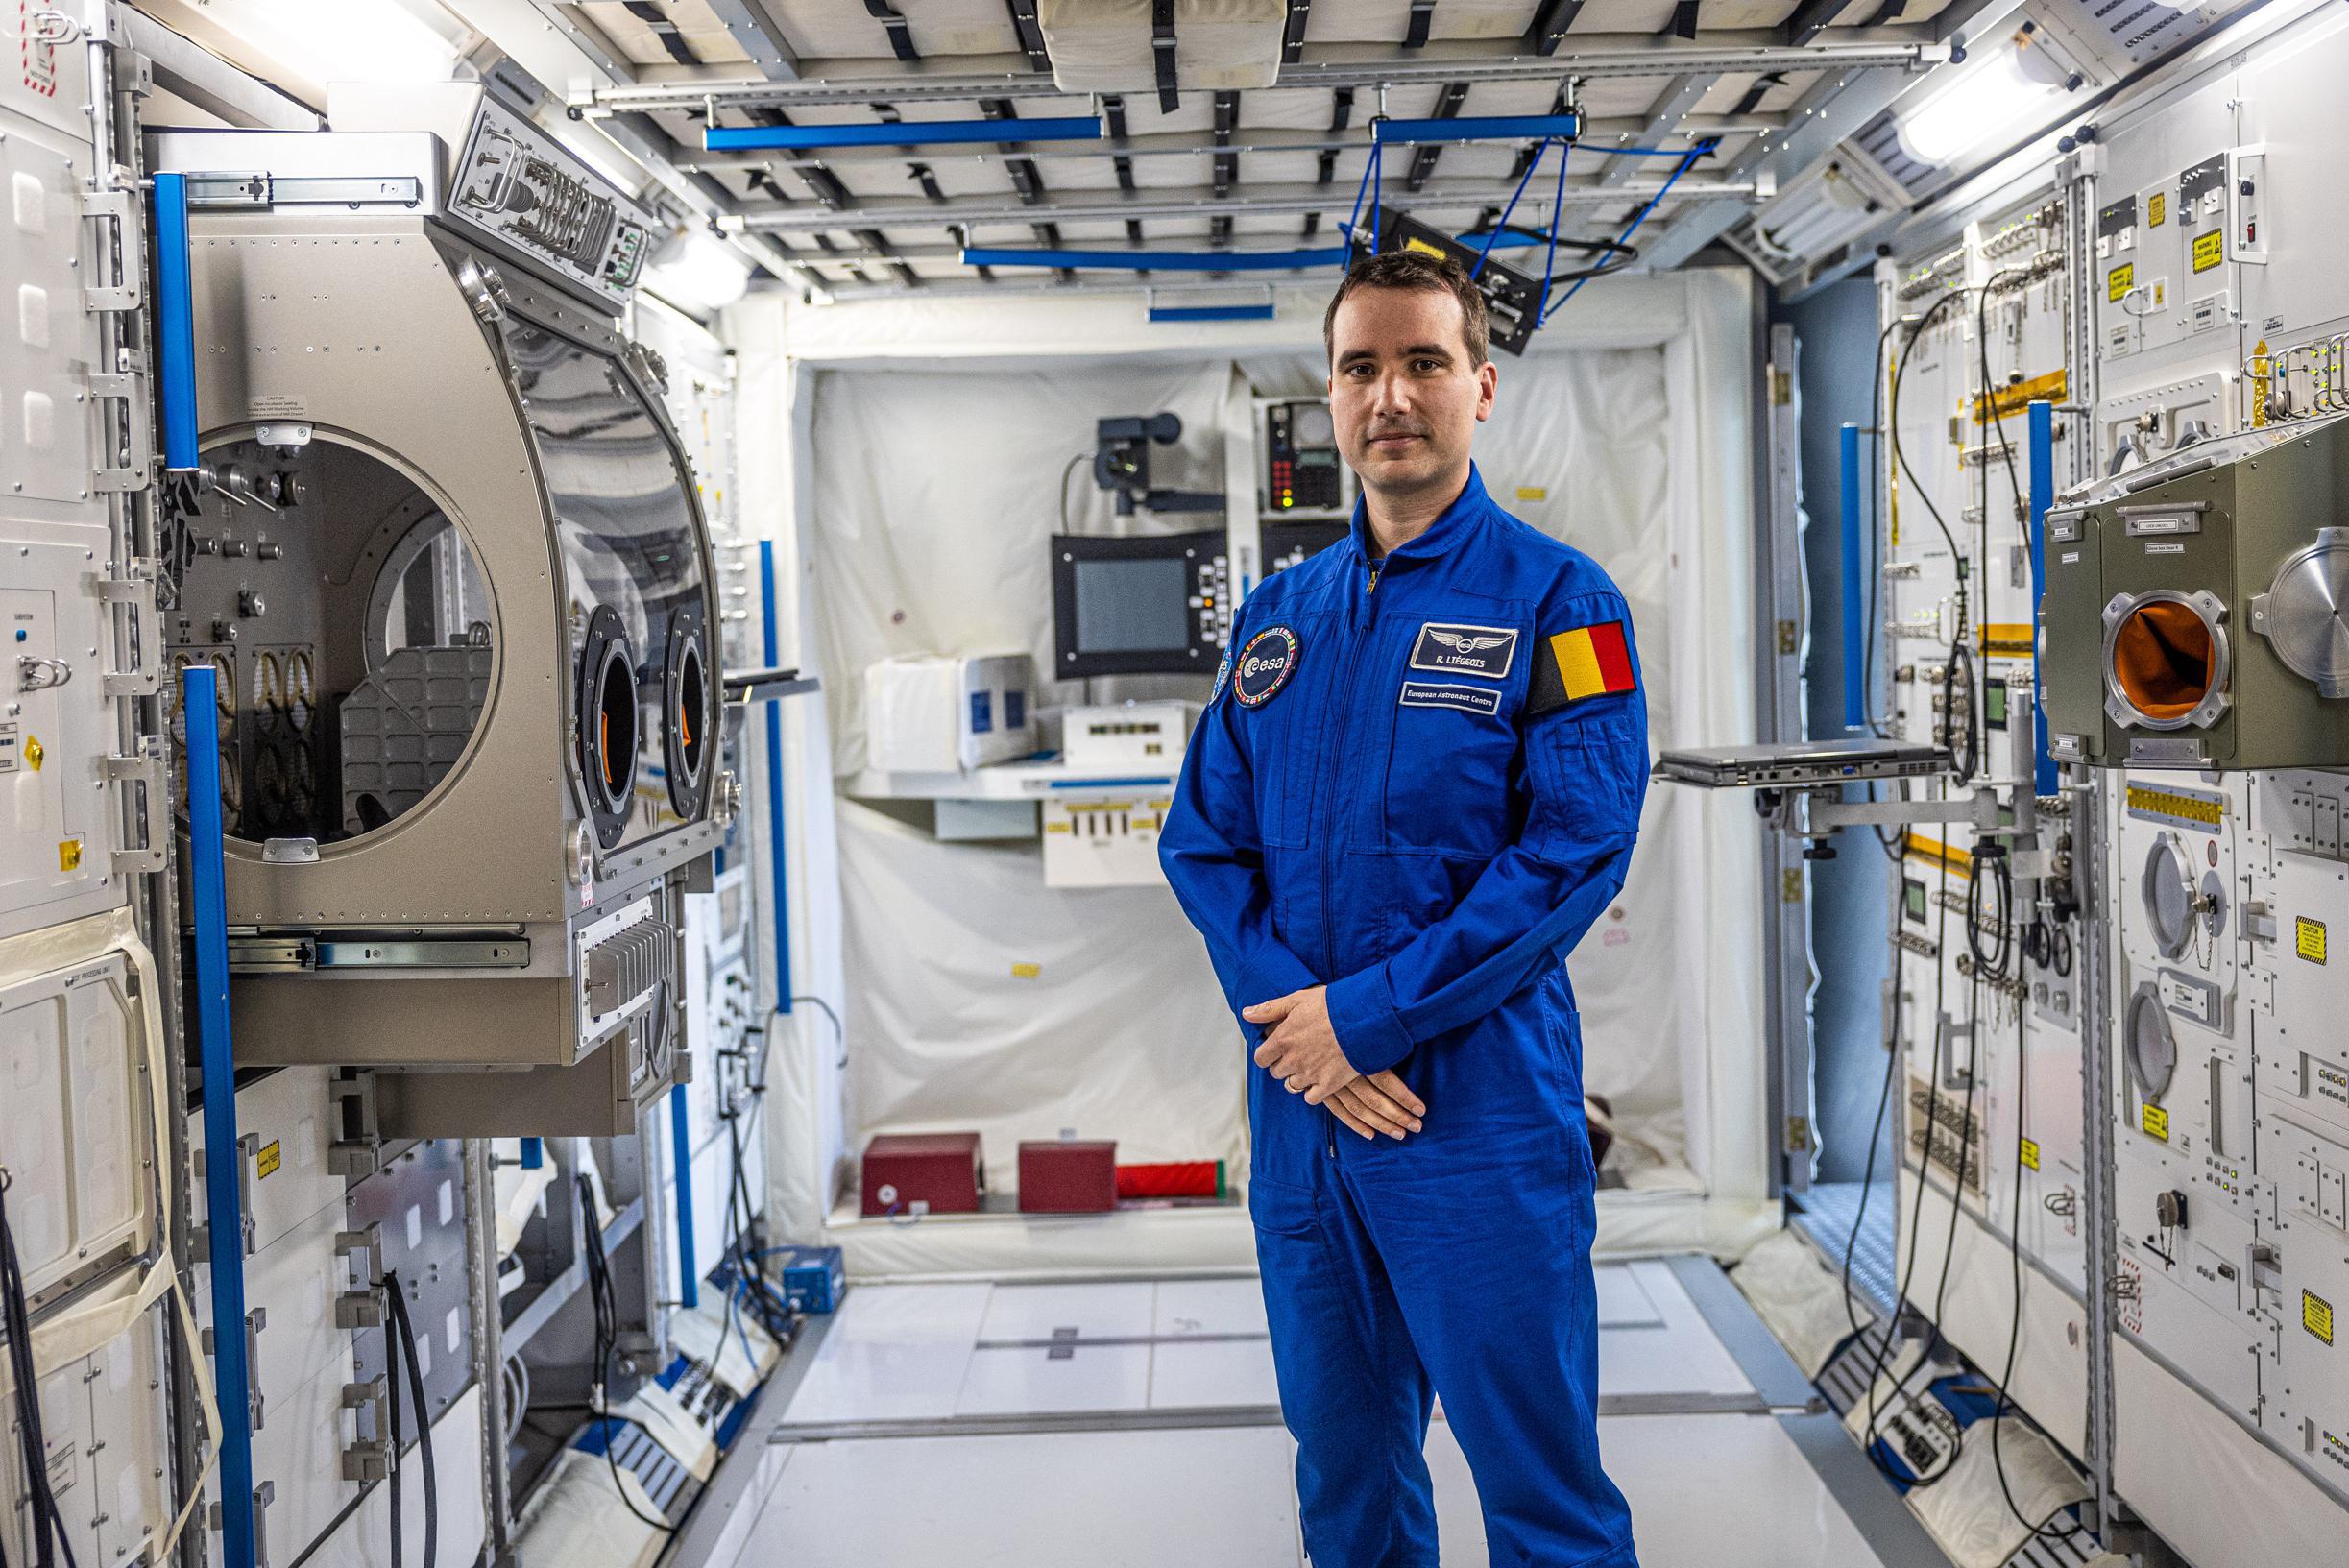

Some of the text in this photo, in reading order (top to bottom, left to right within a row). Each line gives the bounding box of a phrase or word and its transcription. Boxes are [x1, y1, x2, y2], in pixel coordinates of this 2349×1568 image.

[1259, 657, 1285, 672] esa
[1436, 653, 1486, 667] R. LIÉGEOIS
[1407, 689, 1492, 706] European Astronaut Centre
[2303, 925, 2319, 934] CAUTION
[2309, 1299, 2325, 1315] CAUTION
